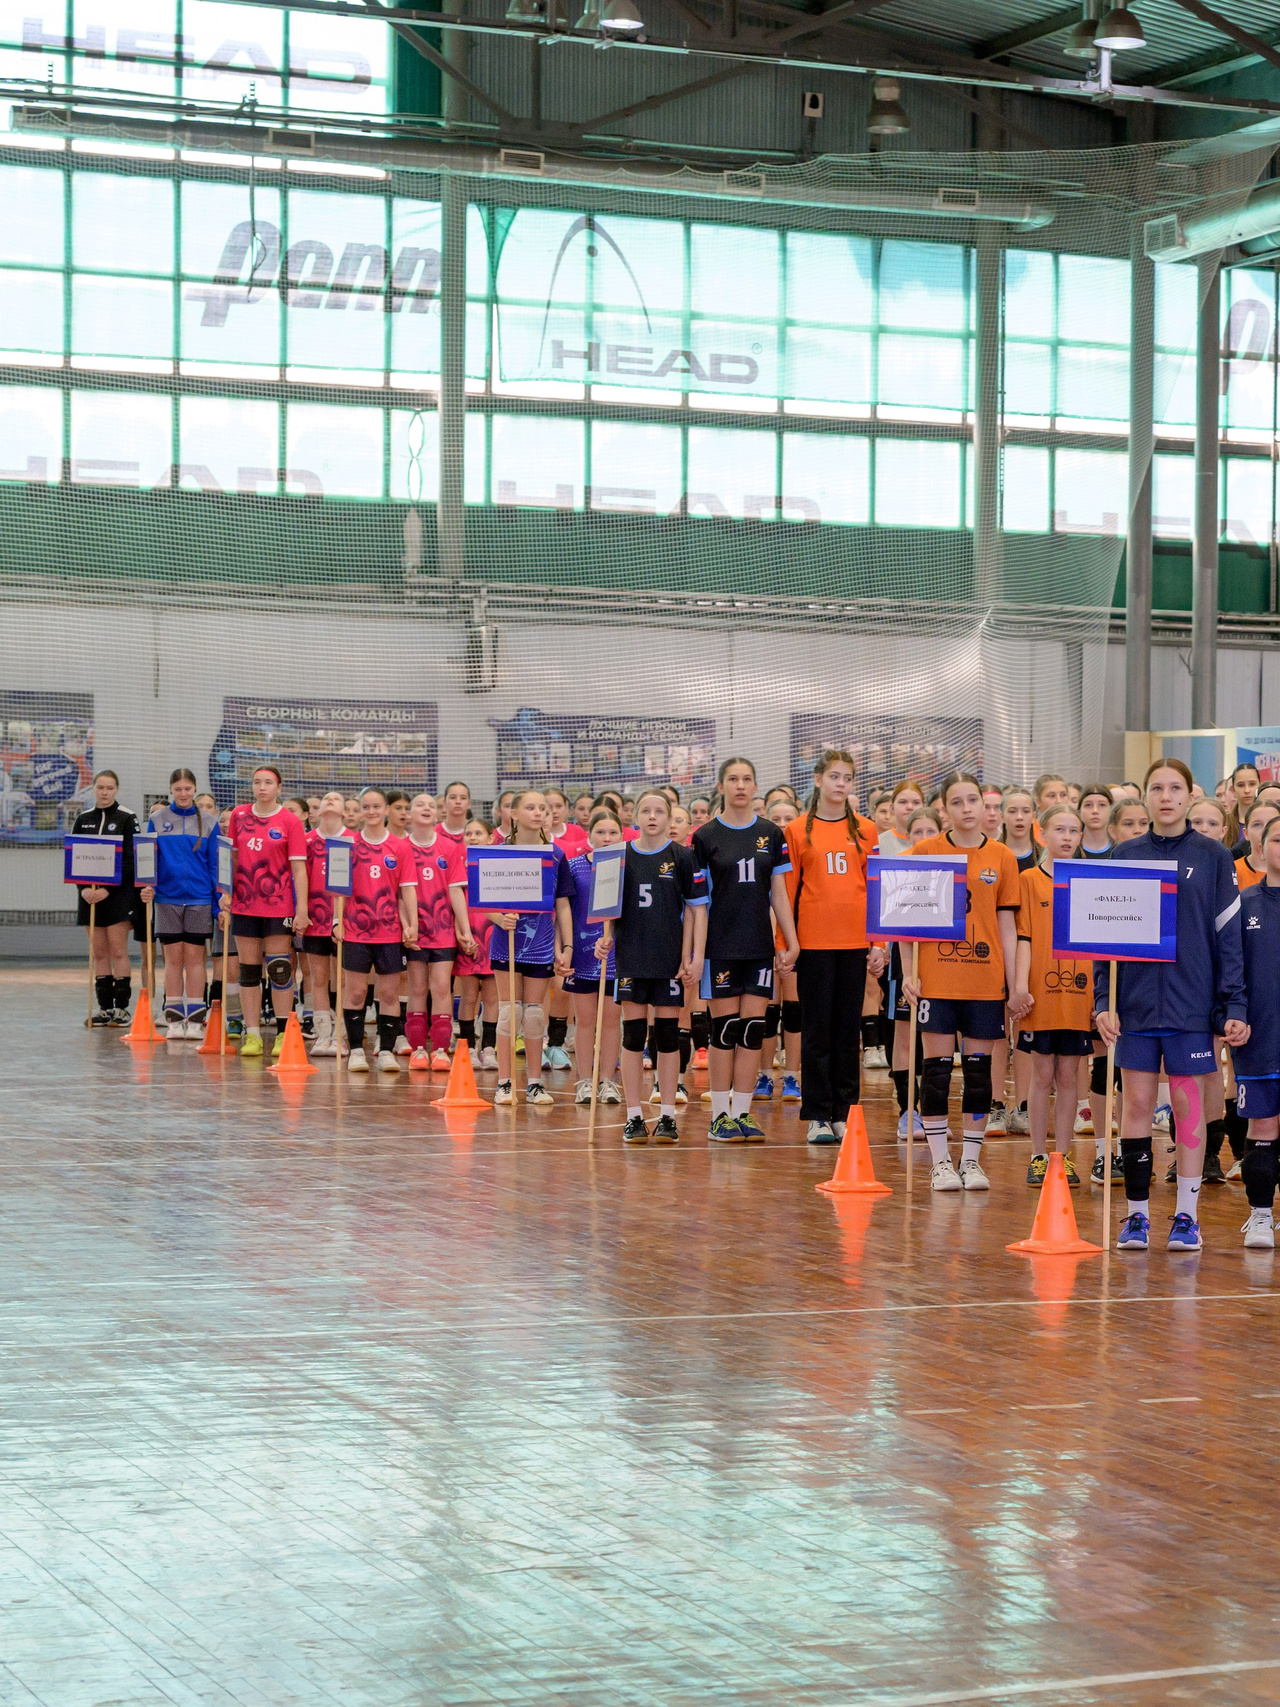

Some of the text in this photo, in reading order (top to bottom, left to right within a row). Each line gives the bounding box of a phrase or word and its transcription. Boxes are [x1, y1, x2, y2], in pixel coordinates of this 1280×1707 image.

[22, 17, 372, 95] HEAD
[552, 340, 758, 384] HEAD
[246, 706, 416, 722] СБОРНЫЕ КОМАНДЫ
[588, 720, 638, 730] ЛУЧШИЕ
[589, 730, 647, 741] КОМАНДЫ
[247, 837, 263, 851] 43
[736, 857, 756, 883] 11
[826, 851, 848, 875] 16
[369, 865, 381, 879] 8
[422, 867, 434, 881] 9
[482, 870, 540, 878] МЕДВЕДОВСКАЯ
[1186, 867, 1194, 879] 7
[638, 883, 653, 907] 5
[1094, 895, 1137, 903] «ФАКЕЛ-1»
[1088, 912, 1143, 922] Новороссийск
[757, 967, 772, 988] 11
[669, 979, 680, 996] 5
[917, 999, 931, 1024] 8
